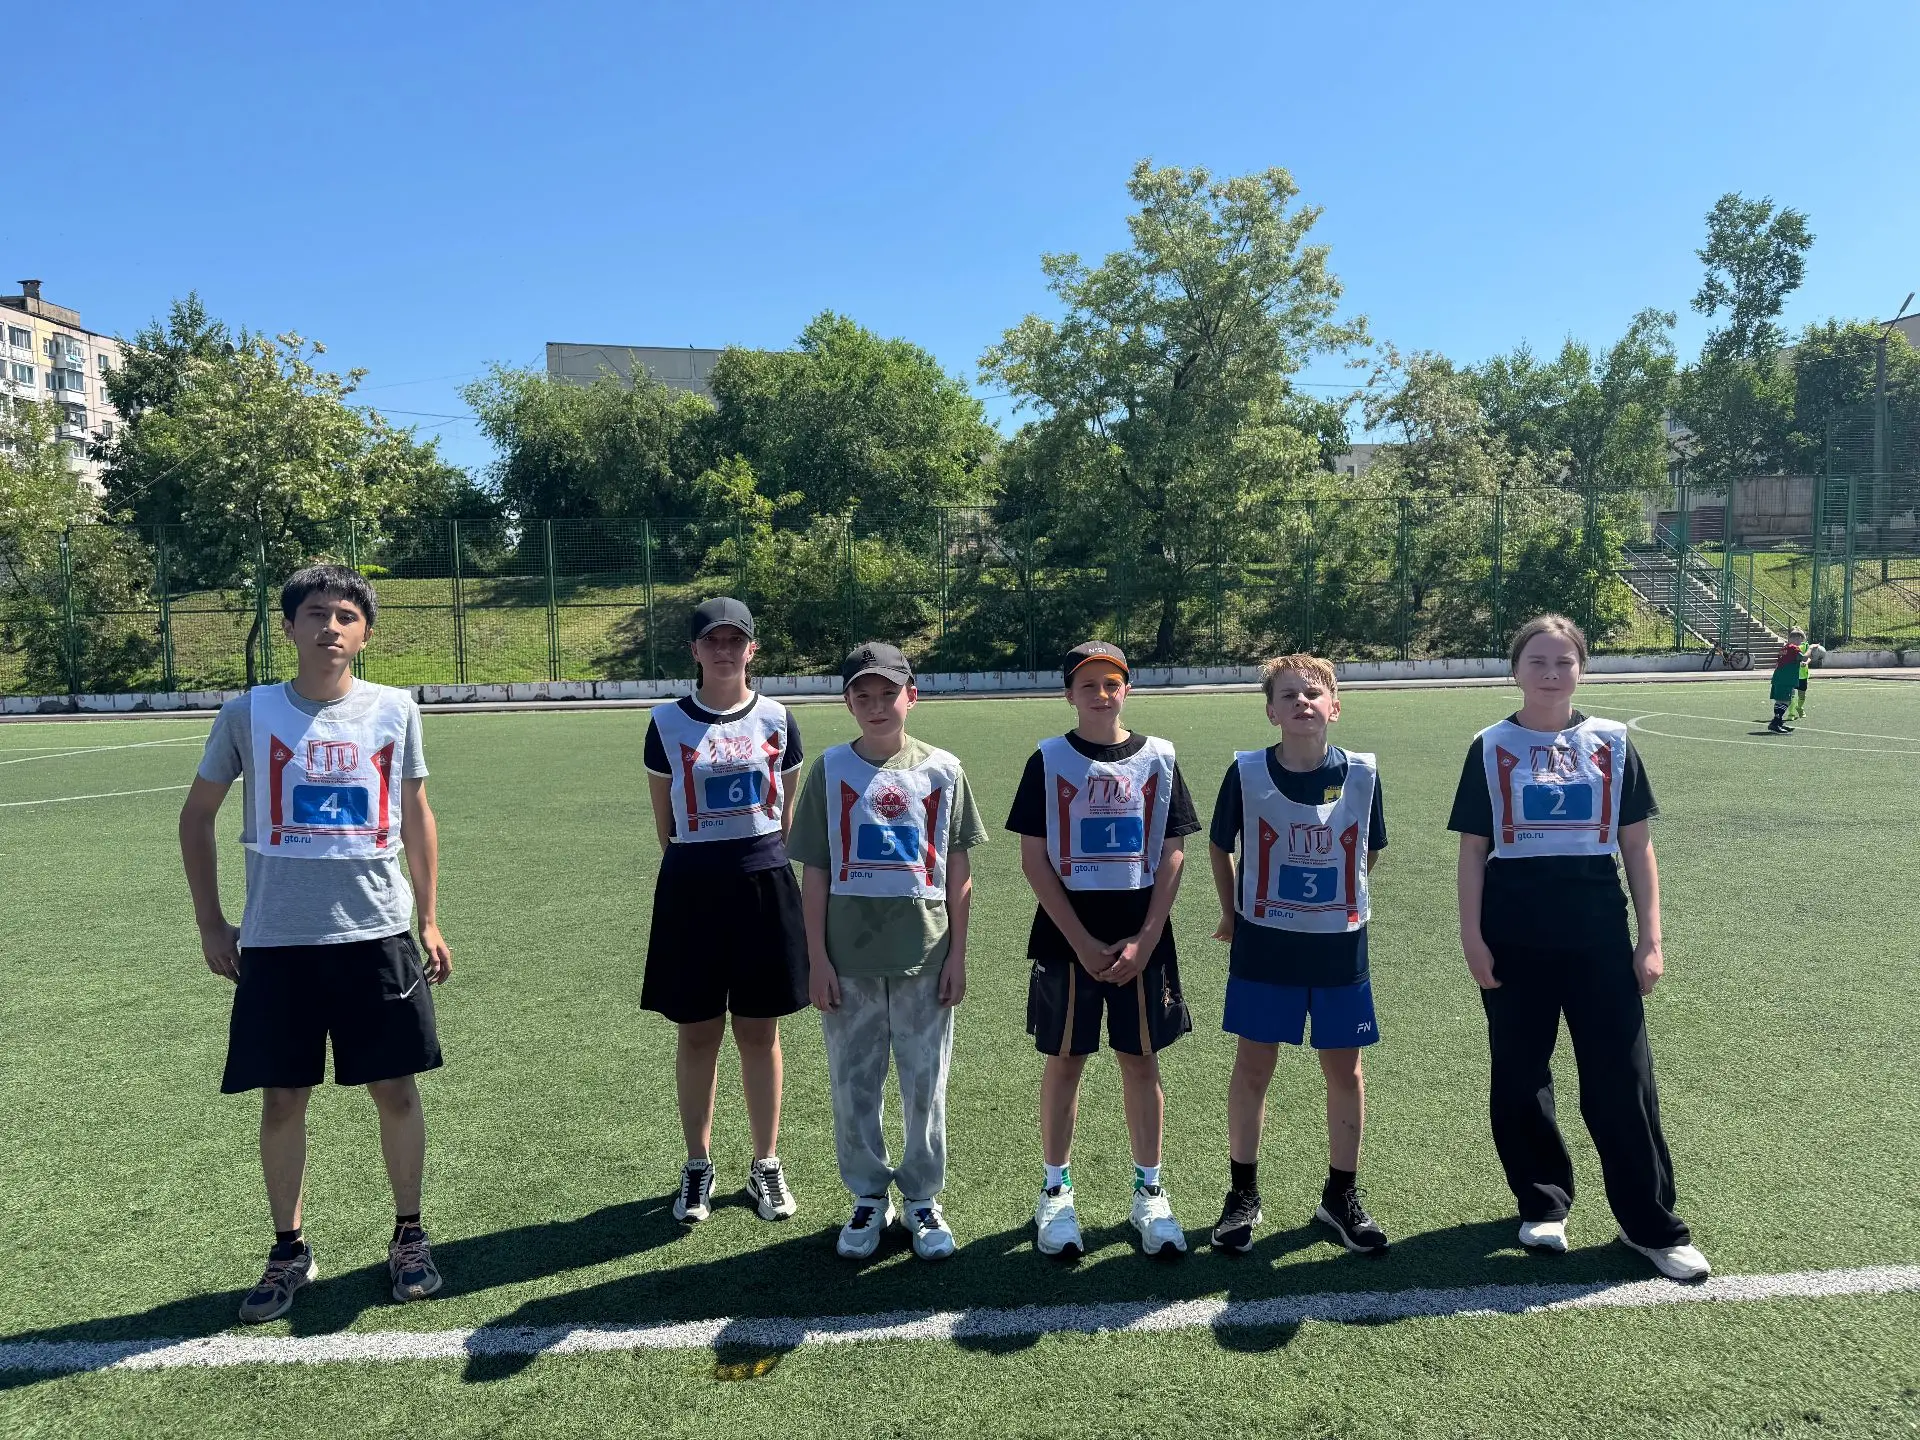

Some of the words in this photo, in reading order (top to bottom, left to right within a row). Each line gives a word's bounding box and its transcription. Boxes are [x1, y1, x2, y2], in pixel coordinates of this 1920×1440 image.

[305, 739, 359, 772] ГТО
[708, 736, 753, 764] ГТО
[1529, 745, 1578, 773] ГТО
[728, 778, 744, 803] 6
[1088, 775, 1132, 803] ГТО
[319, 792, 341, 819] 4
[1549, 791, 1567, 815] 2
[701, 819, 724, 828] gto.ru
[1104, 822, 1121, 848] 1
[1517, 832, 1544, 841] gto.ru
[284, 834, 311, 844] gto.ru
[880, 830, 896, 856] 5
[1288, 822, 1333, 854] ГТО
[850, 871, 873, 879] gto.ru
[1074, 864, 1099, 873] gto.ru
[1302, 872, 1318, 898] 3
[1268, 908, 1294, 919] gto.ru
